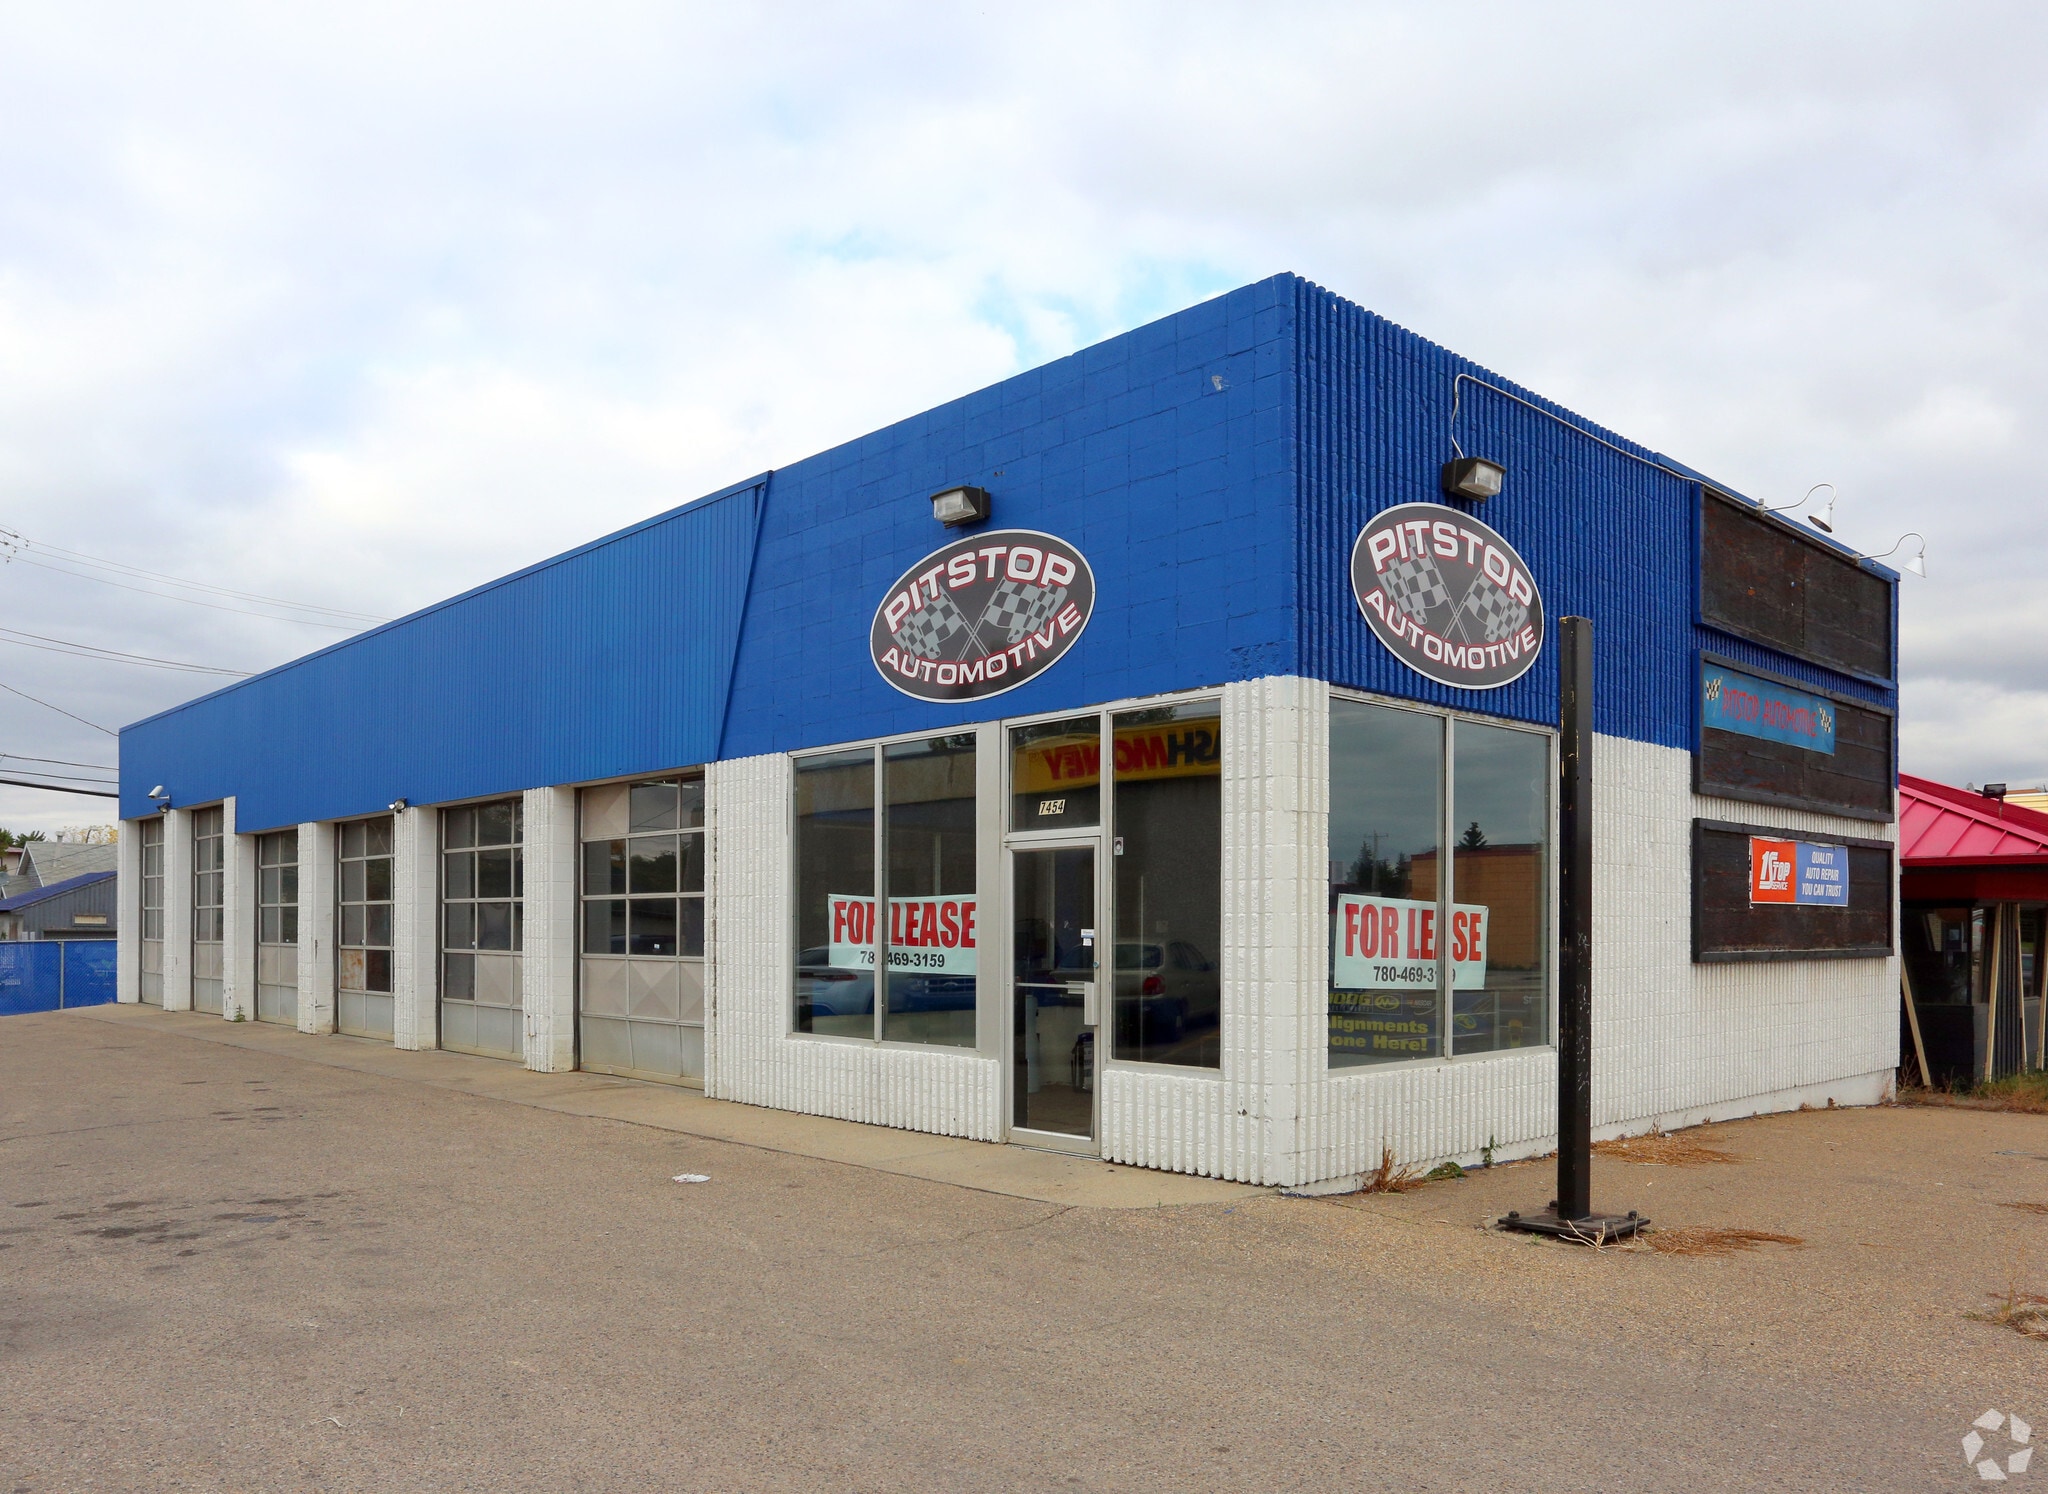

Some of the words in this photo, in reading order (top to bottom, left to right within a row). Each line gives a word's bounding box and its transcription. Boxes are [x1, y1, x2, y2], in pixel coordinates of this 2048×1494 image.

[1367, 520, 1533, 607] PITSTOP
[883, 546, 1076, 633] PITSTOP
[1364, 589, 1537, 670] AUTOMOTIVE
[881, 602, 1082, 685] AUTOMOTIVE
[1722, 686, 1760, 723] PITSTOP
[1762, 698, 1817, 738] AUTOMOTIVE
[1040, 800, 1065, 815] 7454
[1811, 851, 1834, 865] QUALITY
[1805, 867, 1820, 880] AUTO
[1820, 868, 1839, 881] REPAIR
[1802, 883, 1812, 896] YOU
[1813, 883, 1824, 896] CAN
[1825, 884, 1842, 897] TRUST
[891, 901, 977, 948] LEASE
[1345, 903, 1399, 959] FOR
[1407, 908, 1482, 962] LESE
[860, 951, 945, 968] 78469-3159
[1373, 966, 1456, 983] 780-469-3
[1328, 1015, 1429, 1034] lignments
[1328, 1035, 1367, 1048] one
[1373, 1034, 1428, 1051] Here!
